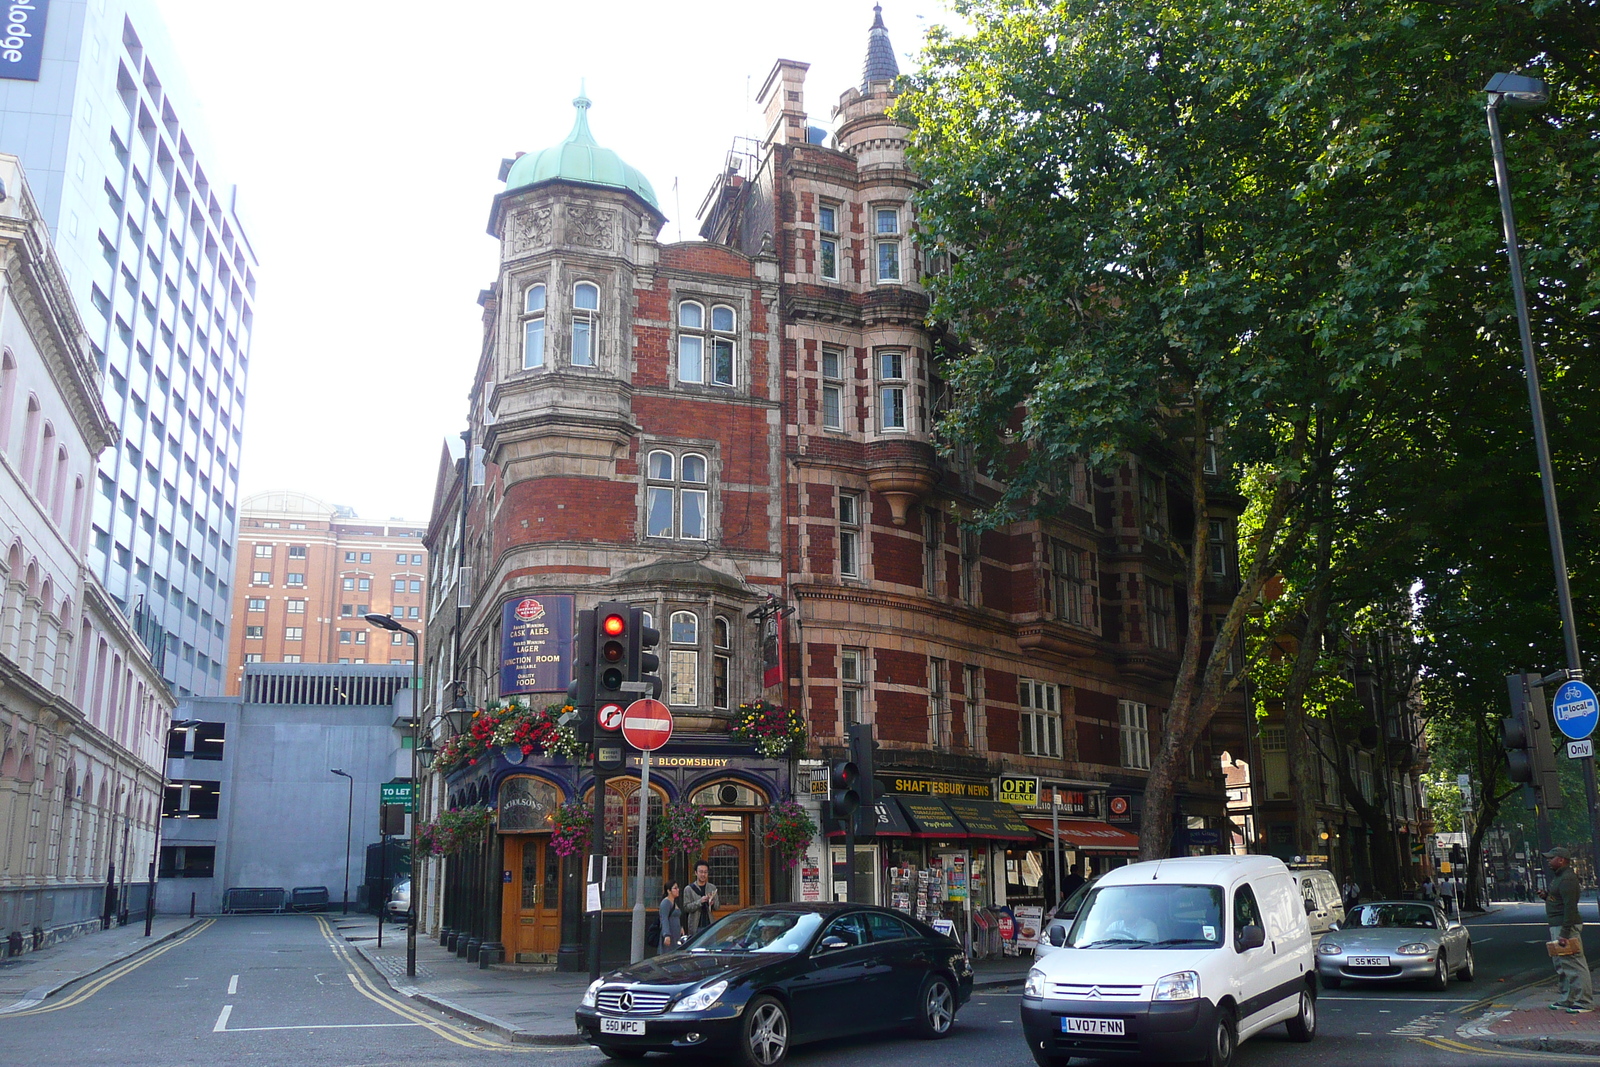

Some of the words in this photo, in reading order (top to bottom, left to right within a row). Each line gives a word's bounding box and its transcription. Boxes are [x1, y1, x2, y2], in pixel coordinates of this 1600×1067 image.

[510, 630, 526, 638] CASK
[516, 645, 539, 653] LAGER
[504, 656, 531, 666] FUNCTION
[1568, 701, 1588, 712] local
[1570, 743, 1589, 755] Only
[634, 757, 653, 765] TE
[658, 758, 728, 767] BLOOMSBURY
[811, 770, 828, 780] MINI
[811, 781, 828, 792] CABS
[895, 779, 966, 795] SHAFTESBURY
[967, 784, 990, 797] NEWS
[1002, 779, 1035, 793] OFF
[383, 788, 394, 796] TO
[1002, 793, 1034, 801] LICENCE
[1074, 804, 1084, 812] BAR
[923, 821, 954, 829] PayPoint
[976, 823, 999, 831] LICENCE
[1100, 1020, 1123, 1033] FNN
